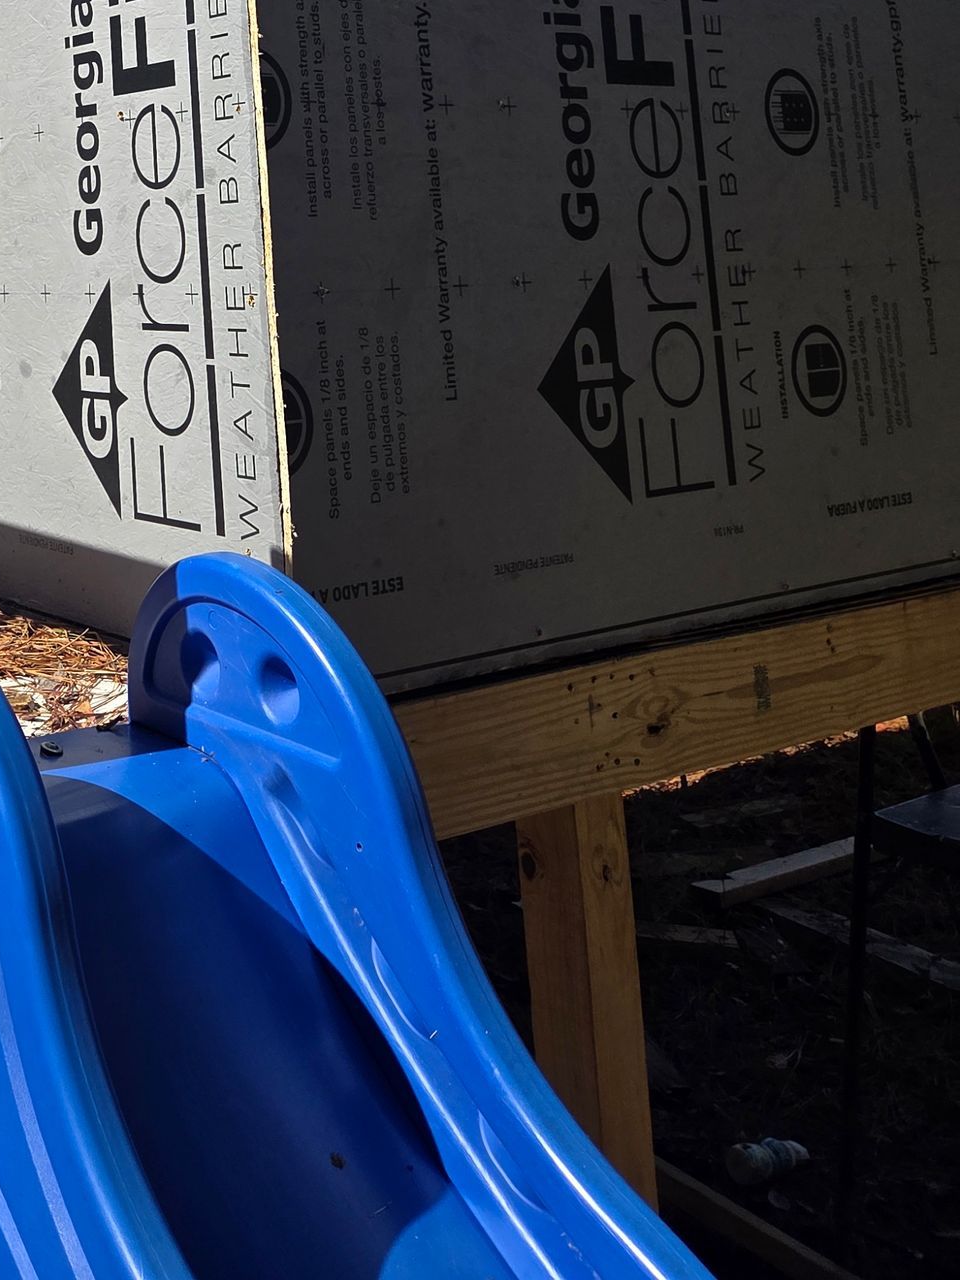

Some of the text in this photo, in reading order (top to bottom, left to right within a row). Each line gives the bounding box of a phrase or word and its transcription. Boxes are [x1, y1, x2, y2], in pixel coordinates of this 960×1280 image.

[424, 119, 437, 142] at:
[426, 147, 444, 231] available
[433, 236, 451, 323] Warranty
[79, 339, 114, 459] GP
[222, 242, 259, 539] WEATHER
[439, 329, 458, 401] Limited
[574, 327, 615, 449] GP
[723, 228, 765, 483] WEATHER
[774, 331, 787, 418] INSTALLATION
[826, 491, 913, 517] ESTE LADO A FUERA
[311, 576, 404, 608] ESTE LADO A
